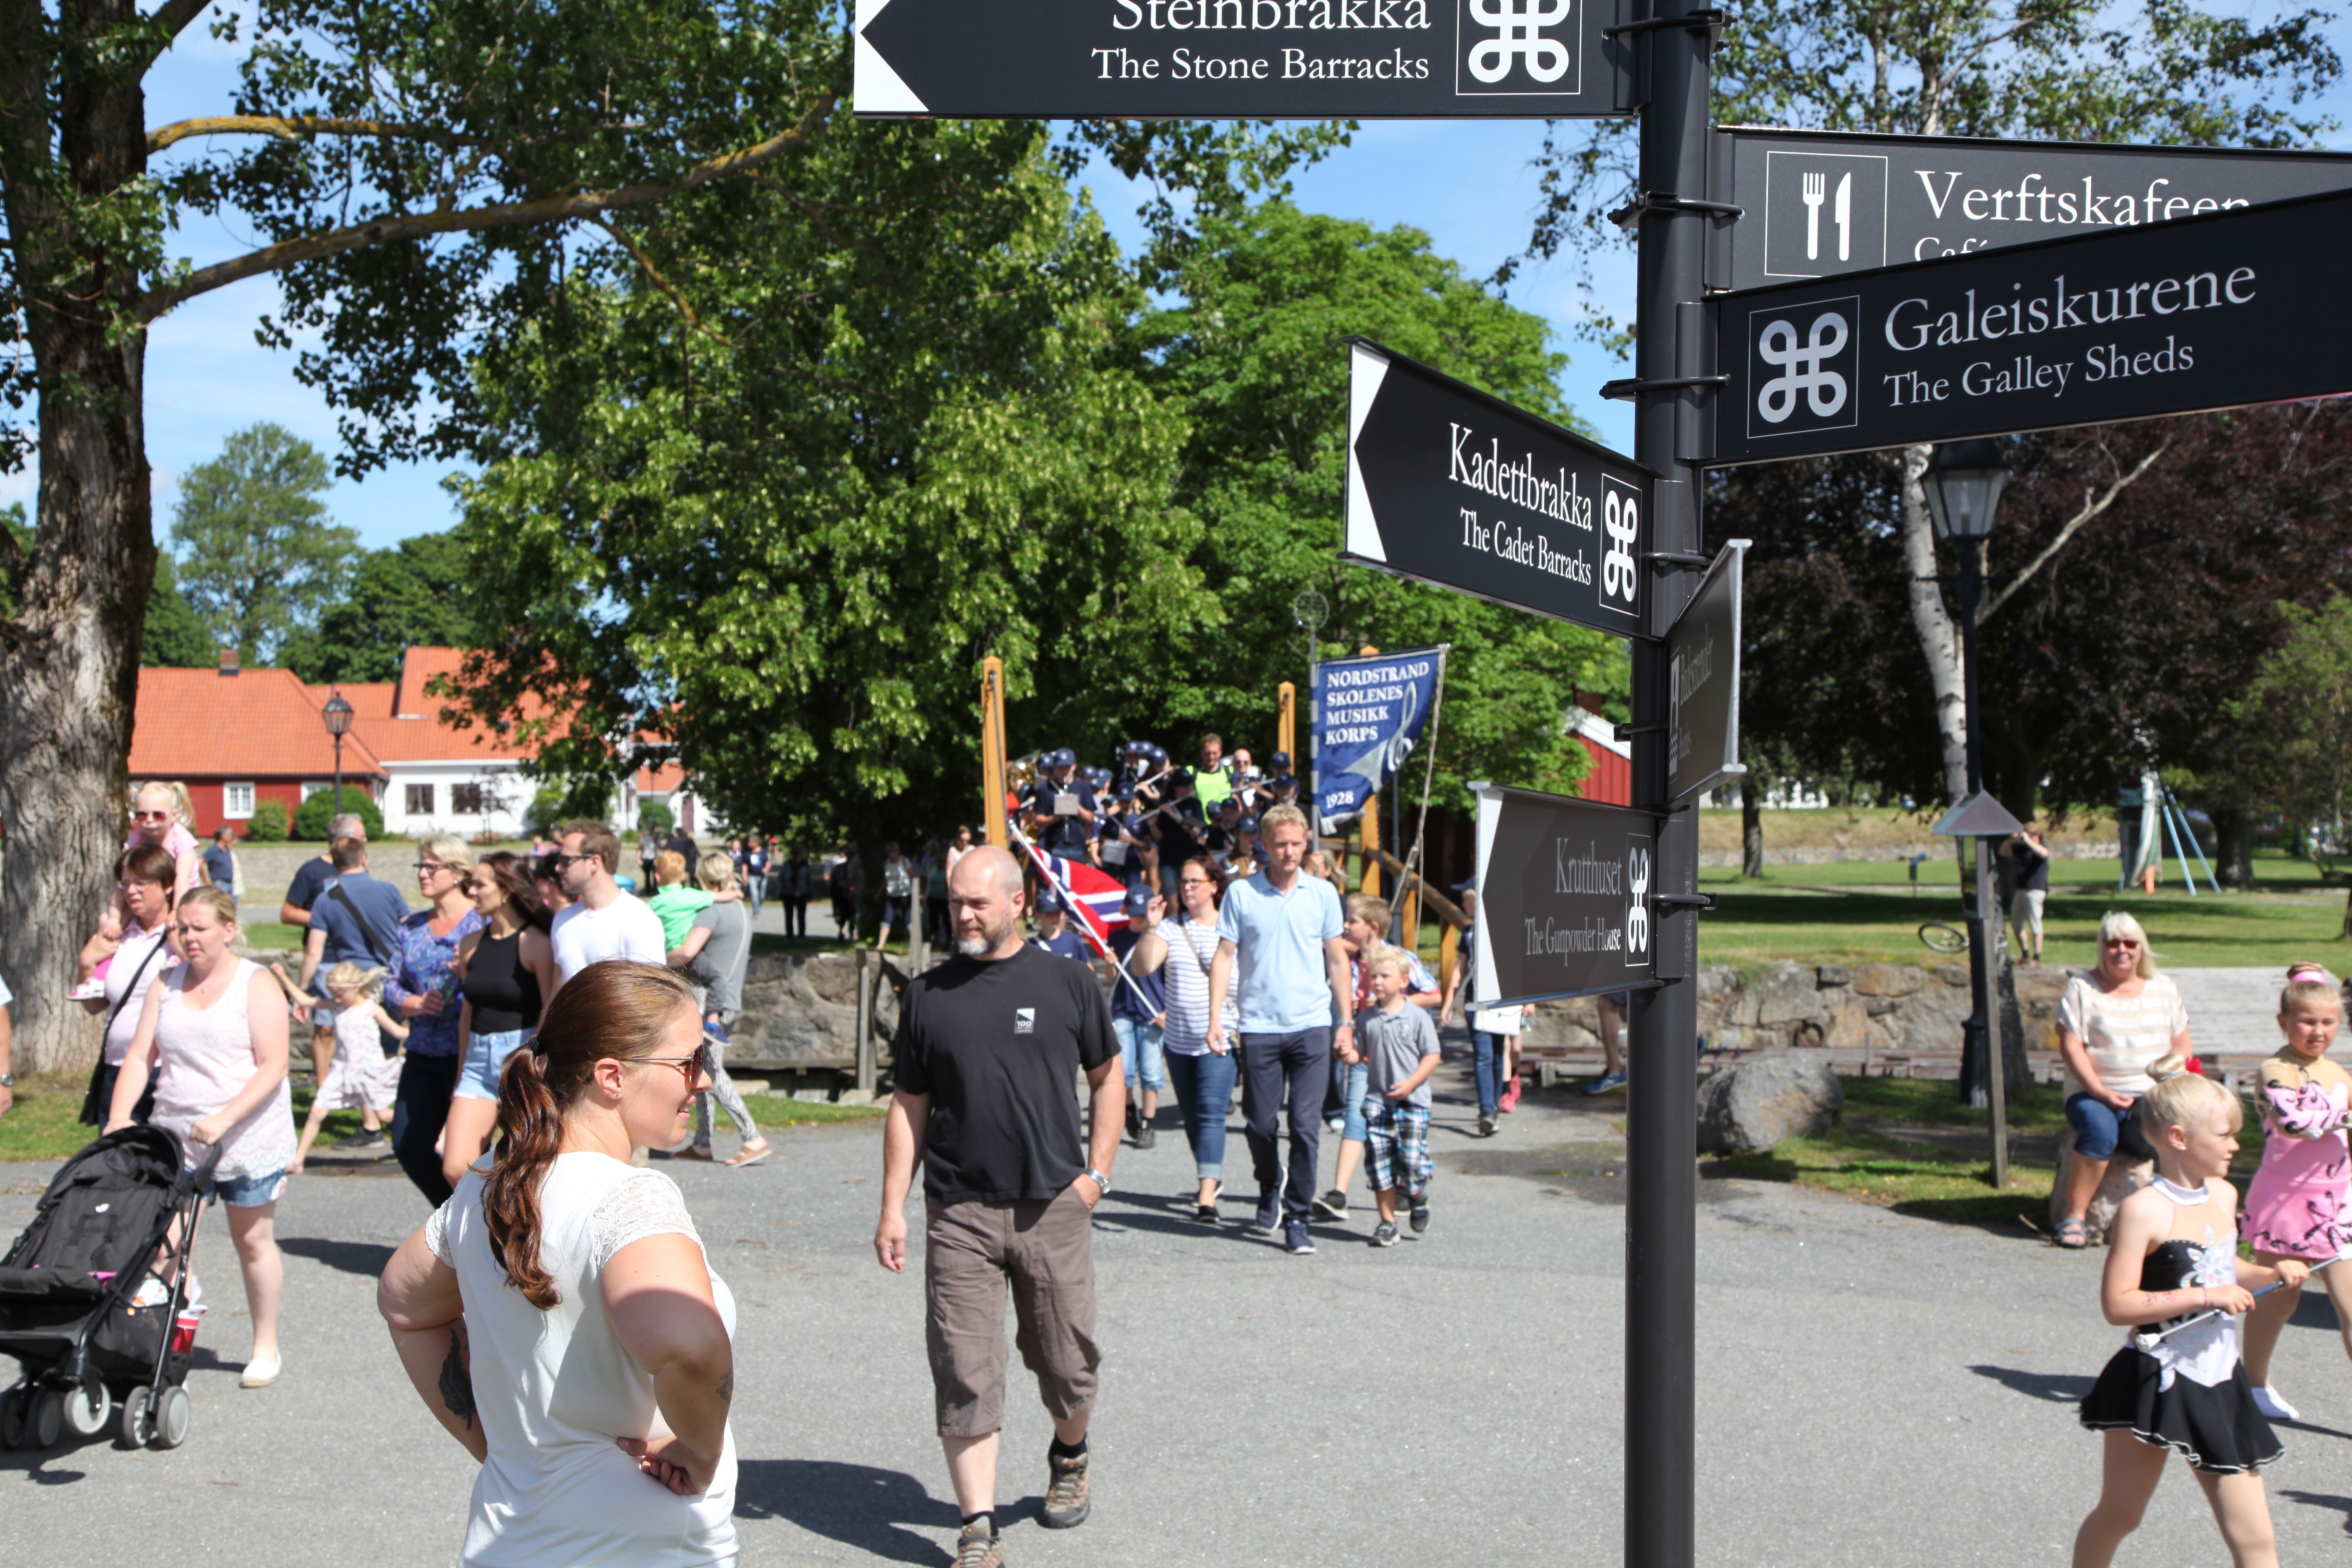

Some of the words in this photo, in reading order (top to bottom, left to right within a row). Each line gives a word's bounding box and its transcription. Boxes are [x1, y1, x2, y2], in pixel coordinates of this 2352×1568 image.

[1113, 0, 1431, 29] Steinbrakka
[1091, 47, 1159, 79] The
[1172, 48, 1269, 79] Stone
[1281, 47, 1429, 79] Barracks
[1885, 267, 2256, 351] Galeiskurene
[1884, 370, 1950, 406] The
[1962, 355, 2074, 397] Galley
[2086, 335, 2194, 381] Sheds
[1449, 422, 1593, 531] Kadettbrakka
[1460, 507, 1490, 552] The
[1494, 521, 1534, 567] Cadet
[1537, 535, 1591, 585] Barracks
[1327, 662, 1429, 688] NORDSTRAND
[1326, 685, 1403, 707] SKOLENES
[1326, 705, 1390, 726] MUSIKK
[1325, 726, 1378, 745] KORPS
[1326, 790, 1354, 809] 1928
[1555, 838, 1622, 895] Krutthuset
[1524, 917, 1544, 956] The
[1545, 916, 1596, 967] Gunpowder
[1596, 917, 1621, 951] House
